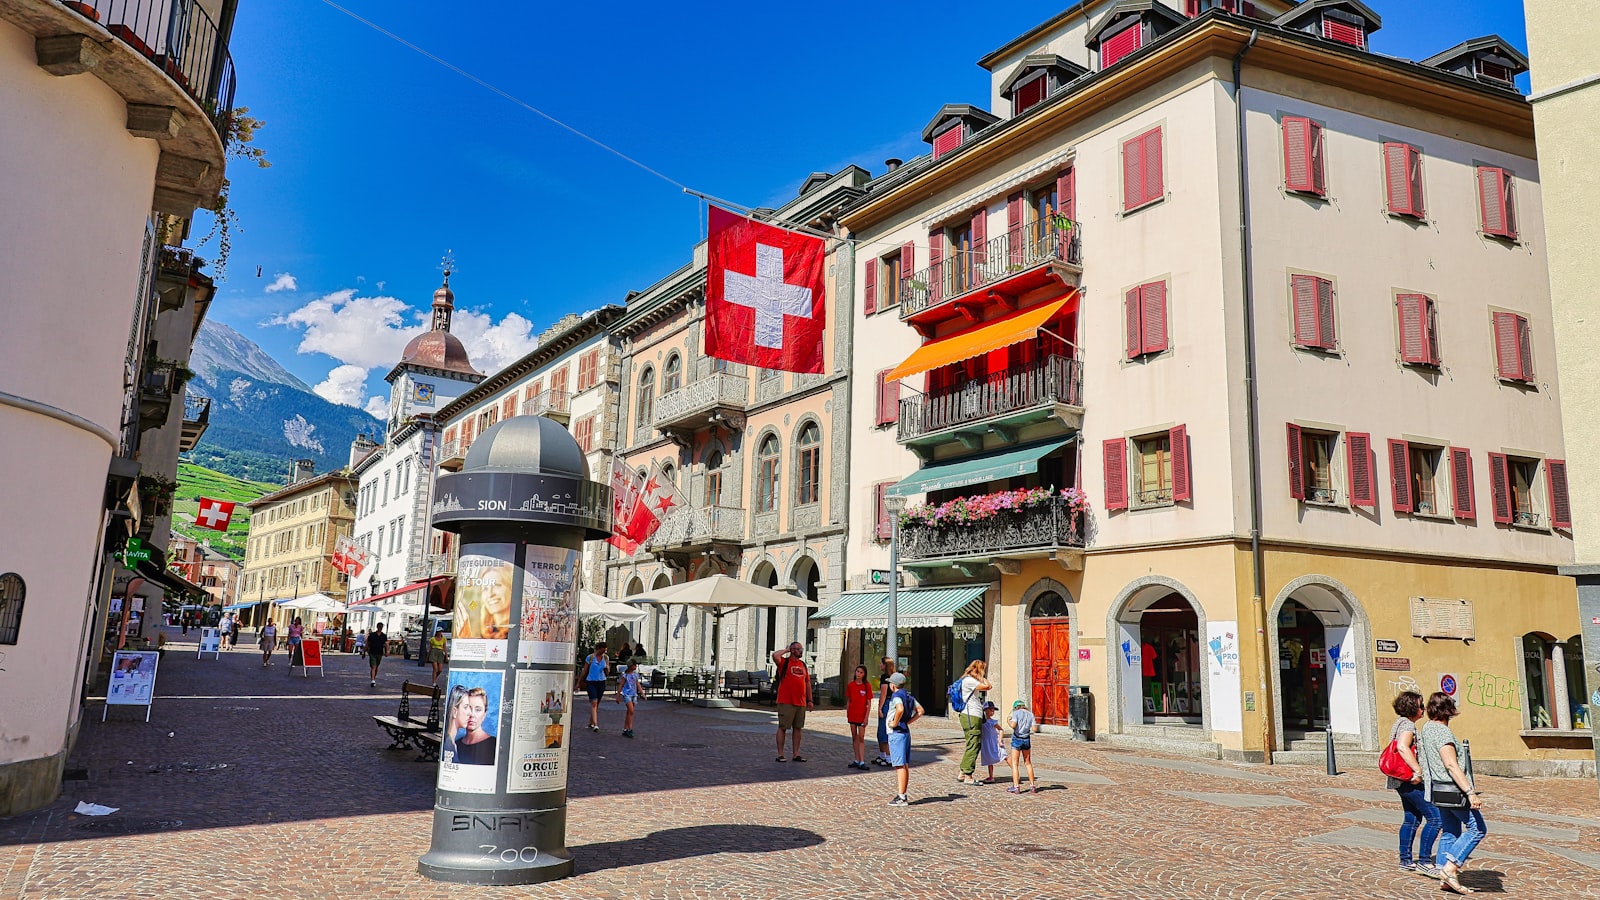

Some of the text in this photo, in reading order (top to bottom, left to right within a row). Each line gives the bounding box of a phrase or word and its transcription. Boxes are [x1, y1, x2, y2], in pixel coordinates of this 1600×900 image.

[477, 500, 507, 511] SION
[869, 618, 887, 627] QUAY
[523, 761, 559, 772] ORGUE
